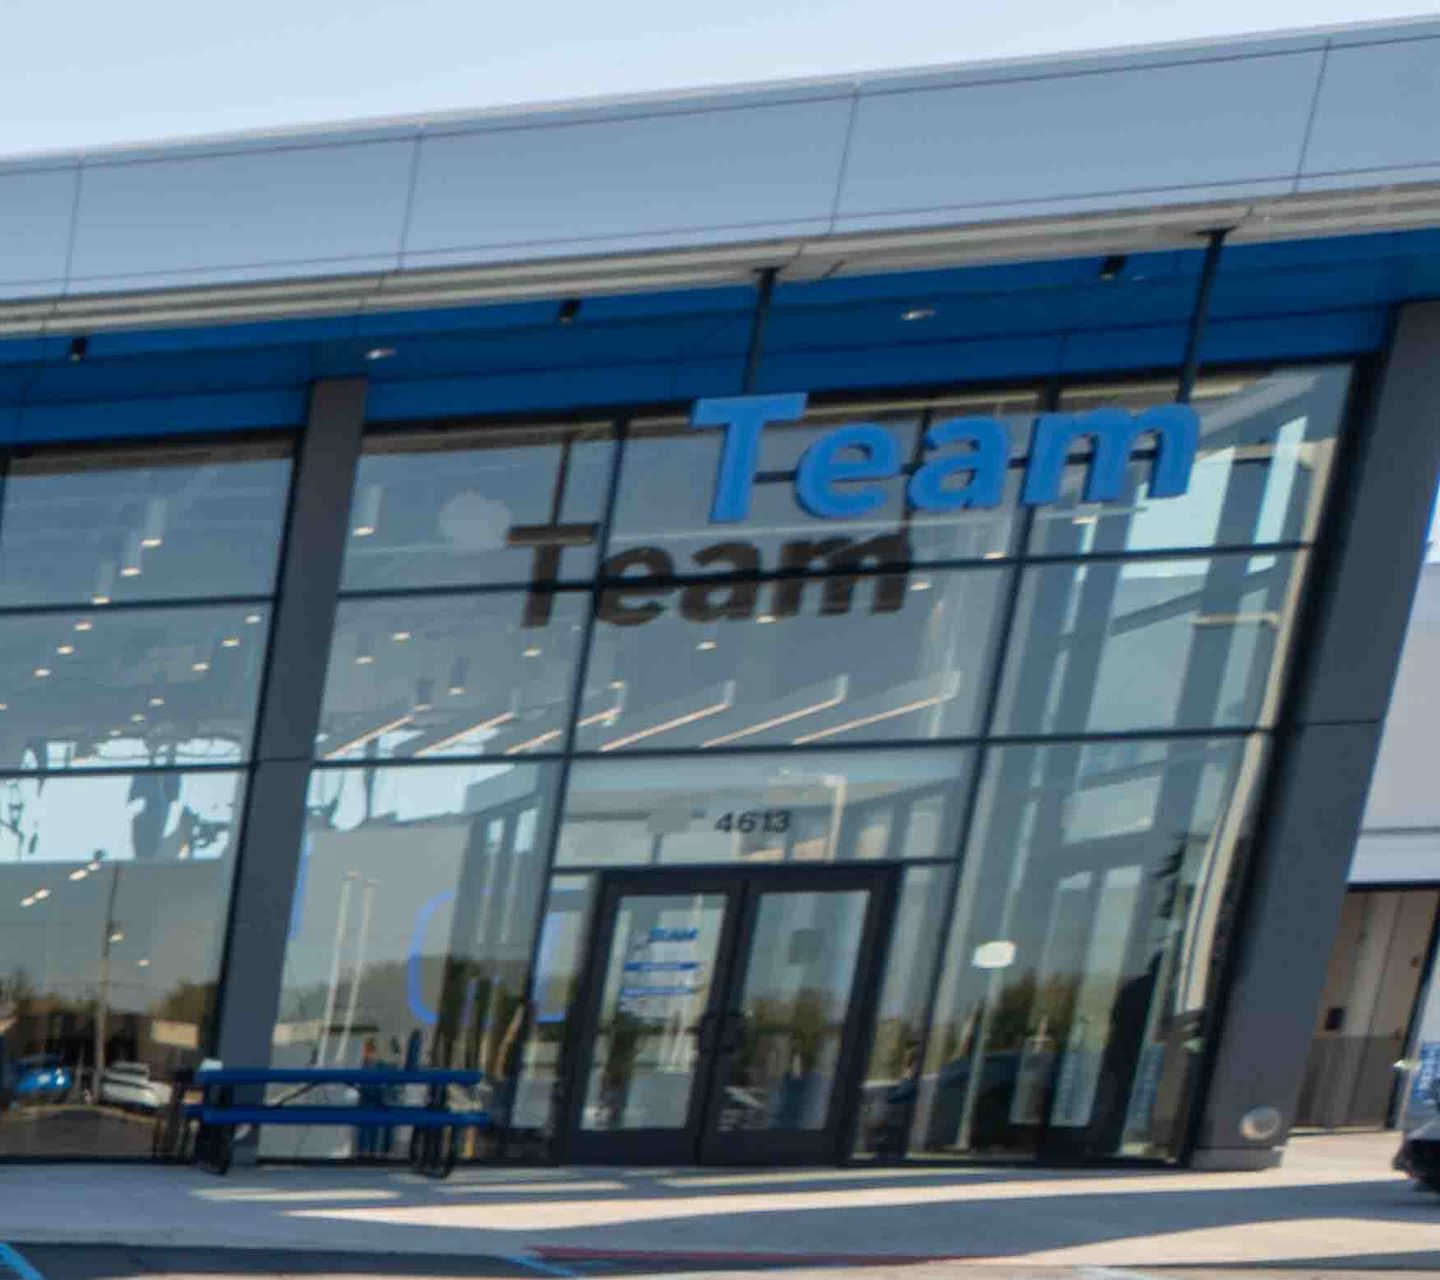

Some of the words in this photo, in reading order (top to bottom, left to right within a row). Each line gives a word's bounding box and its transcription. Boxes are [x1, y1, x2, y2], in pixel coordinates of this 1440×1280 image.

[689, 392, 1200, 523] Team
[507, 523, 912, 628] Team
[715, 809, 791, 833] 4613
